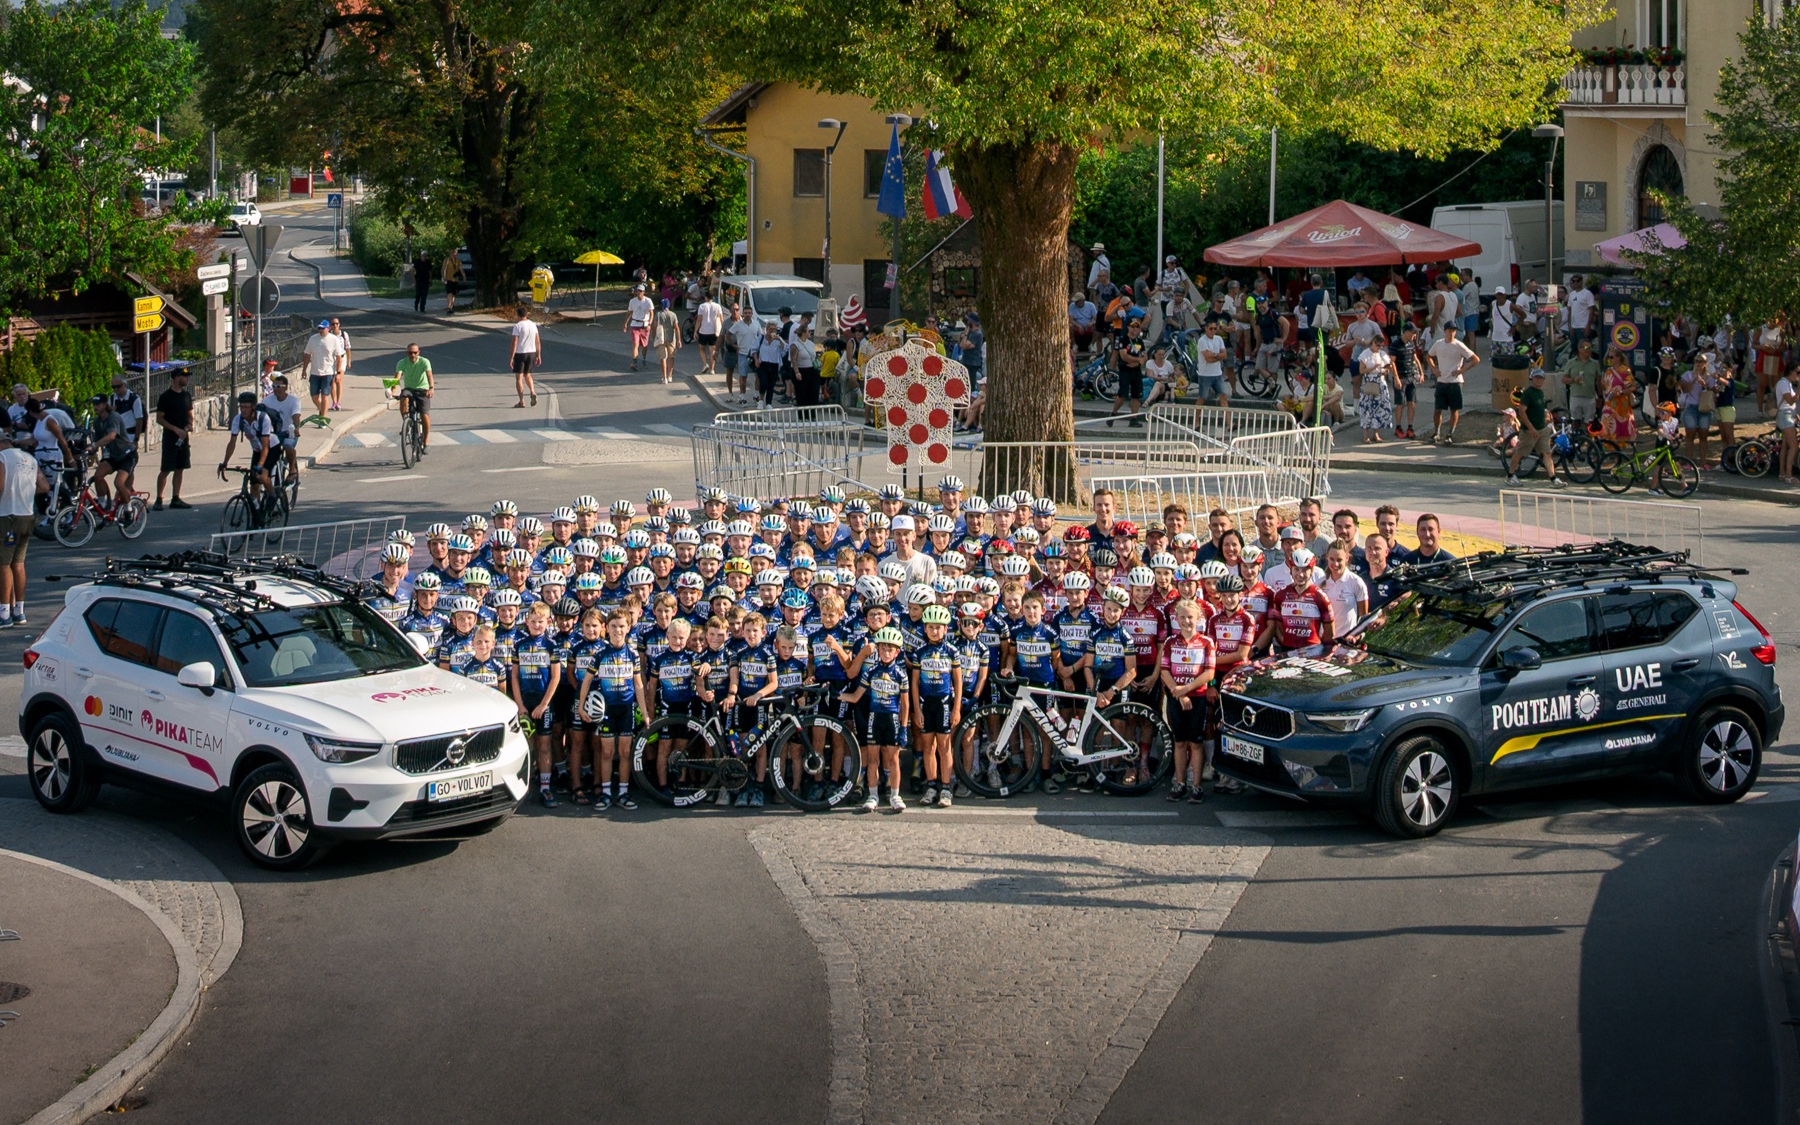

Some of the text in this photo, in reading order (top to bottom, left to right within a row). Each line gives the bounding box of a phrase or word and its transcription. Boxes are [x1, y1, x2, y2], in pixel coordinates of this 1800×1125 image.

[1307, 226, 1362, 242] Union
[137, 301, 153, 311] Kamnik
[137, 319, 154, 329] Moste
[1615, 663, 1663, 693] UAE
[1396, 695, 1454, 711] VOLVO
[1628, 694, 1667, 709] GENERALI
[109, 703, 133, 722] DINIT
[962, 707, 998, 730] BLACK
[1492, 695, 1572, 730] POGITEAM
[155, 718, 223, 755] PIKATEAM
[248, 718, 289, 737] VOLVO
[1030, 707, 1068, 751] FACTOR
[1122, 705, 1173, 757] BLACK INC
[747, 719, 782, 758] COLNAGO
[1613, 734, 1655, 749] LJUBLJANA
[110, 746, 139, 762] LJUBLJANA
